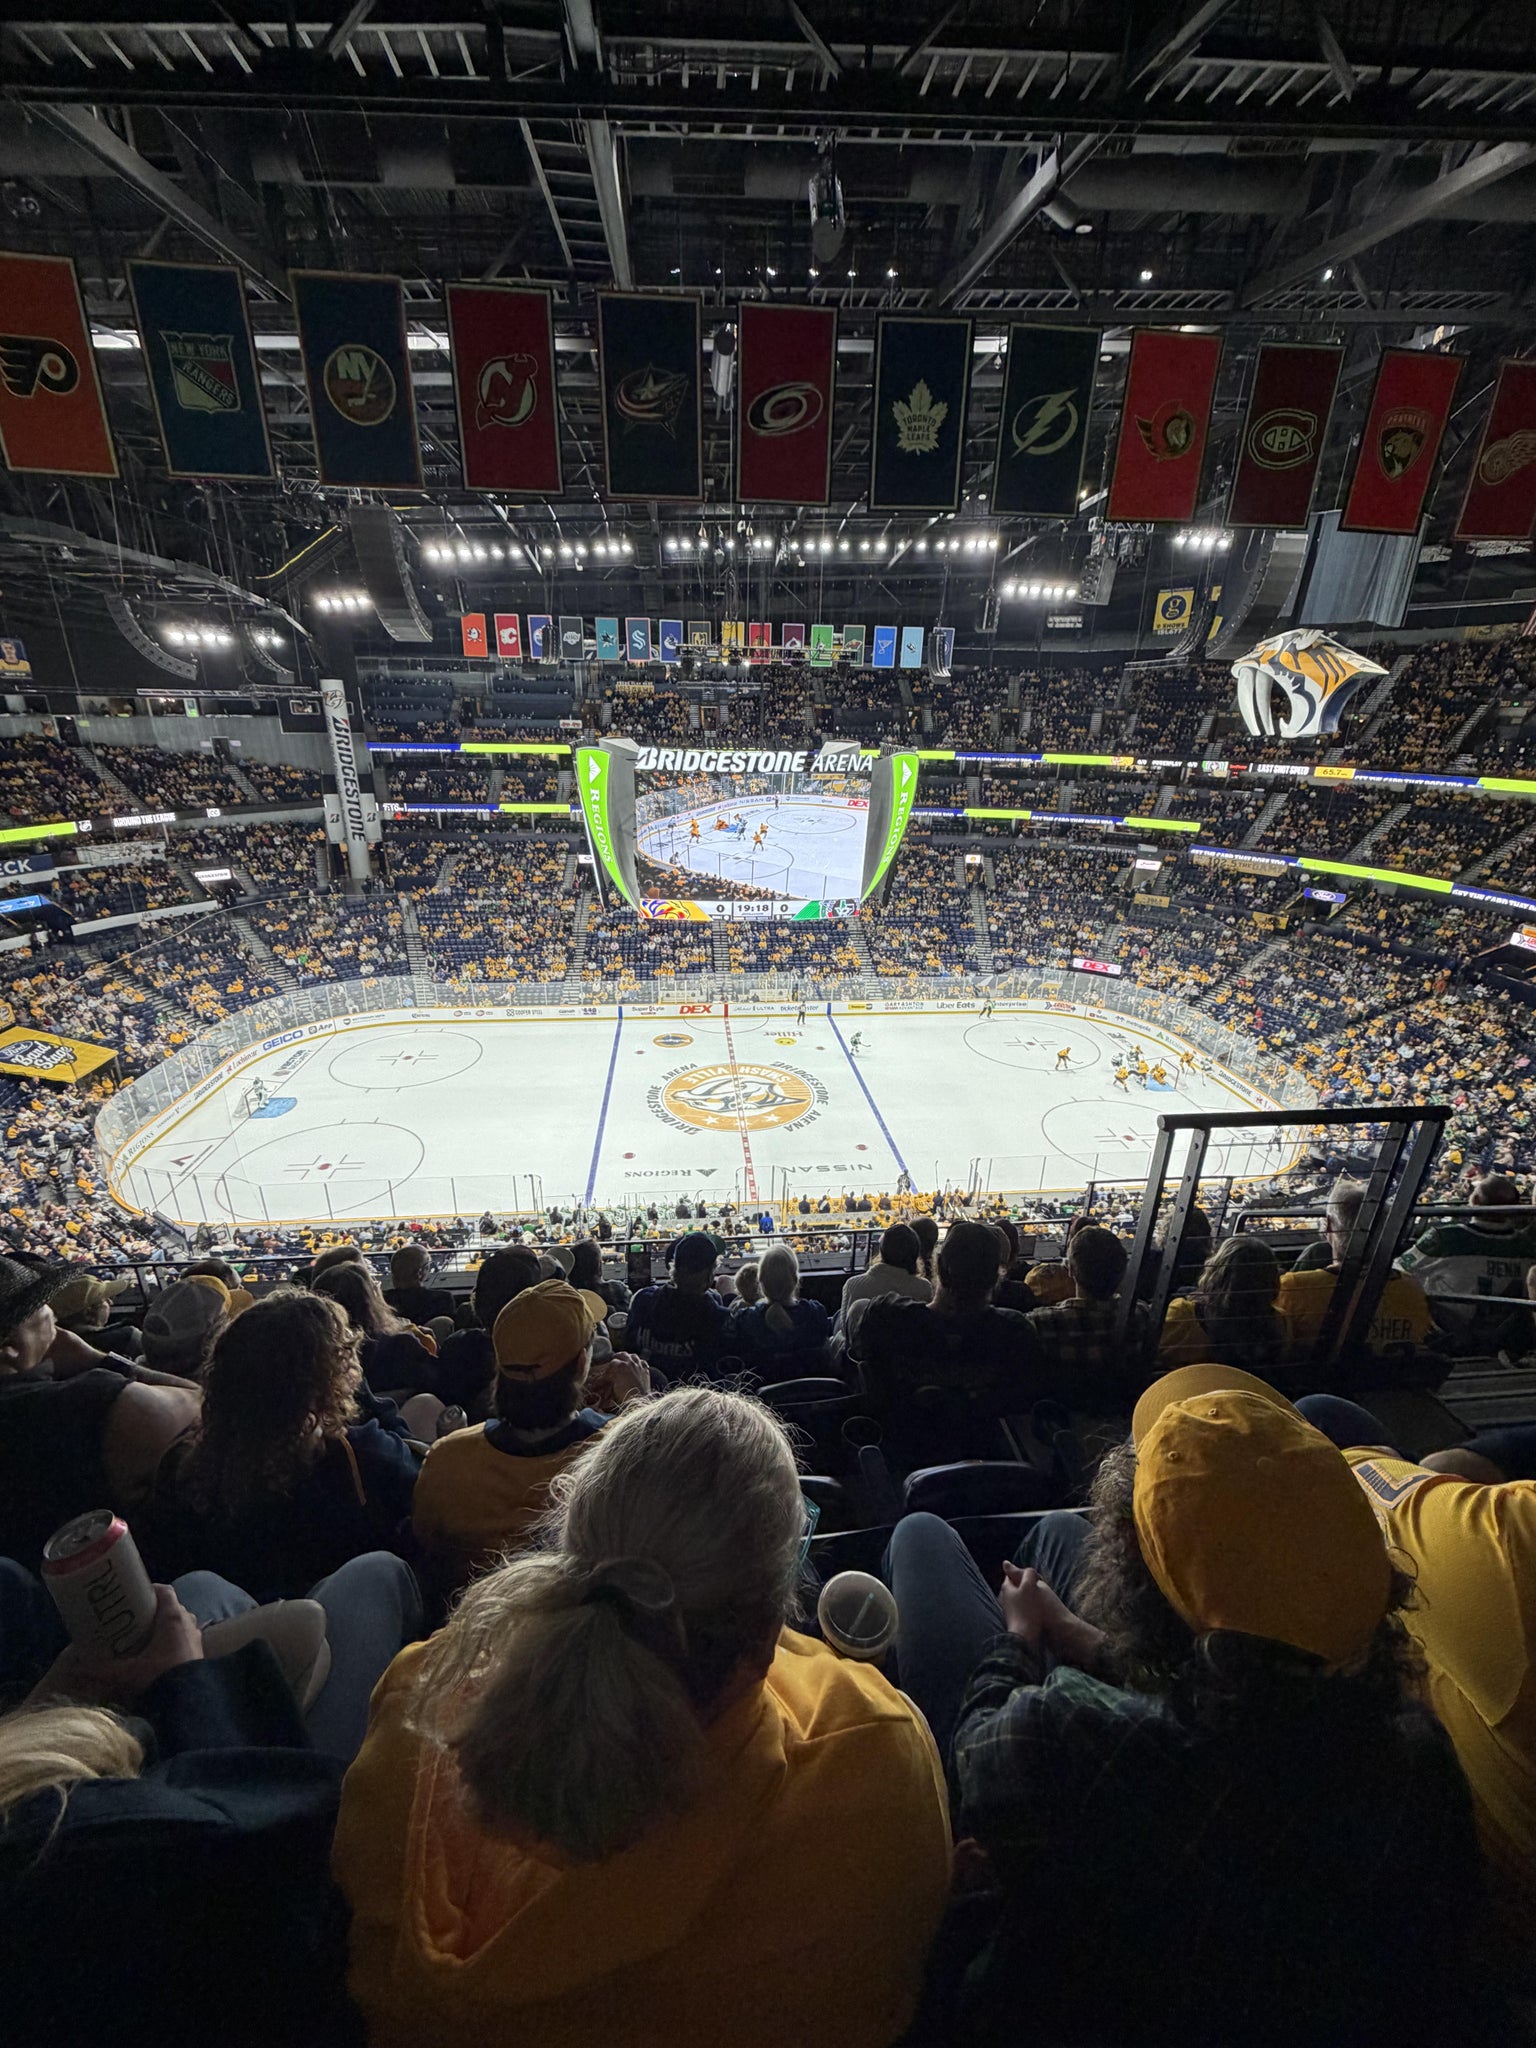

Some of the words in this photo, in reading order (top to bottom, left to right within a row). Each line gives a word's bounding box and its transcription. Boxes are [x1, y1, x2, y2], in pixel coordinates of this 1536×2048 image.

[170, 341, 195, 357] NEW
[199, 344, 229, 360] YORK
[182, 360, 235, 405] RANGERS
[903, 413, 937, 427] TORONTO
[906, 424, 931, 433] MAPLE
[906, 433, 930, 441] LEAFS
[635, 747, 808, 773] BRIDGESTONE
[810, 754, 873, 772] ARENA
[1257, 763, 1274, 773] LAST
[1273, 765, 1290, 774] SHOT
[1290, 766, 1310, 775] SPEED
[332, 716, 366, 842] BRIDGESTONE
[847, 799, 869, 808] DEX
[113, 815, 141, 828] AROUND
[140, 814, 154, 825] THE
[153, 812, 176, 823] LEAGUE
[589, 788, 614, 863] REGIONS
[883, 791, 909, 863] REGIONS
[715, 904, 725, 913] 0
[738, 904, 769, 912] 19:18
[780, 903, 789, 913] 0
[1082, 960, 1111, 971] DEX
[679, 1004, 713, 1014] DEX
[936, 1001, 955, 1009] Uber
[956, 1000, 976, 1009] Eats
[263, 1030, 304, 1051] GEICO
[10, 1040, 52, 1067] Band
[33, 1046, 75, 1069] Stage
[661, 1063, 699, 1081] ARENA
[770, 1061, 830, 1106] BRIDGESTONE
[1218, 1069, 1253, 1097] BRIDGESTONE
[646, 1084, 703, 1136] BRIDGESTONE
[783, 1109, 822, 1133] ARENA
[127, 1131, 154, 1157] REGIONS
[624, 1169, 692, 1178] REGIONS
[780, 1163, 873, 1173] NISSAN
[1486, 1260, 1522, 1277] BENN
